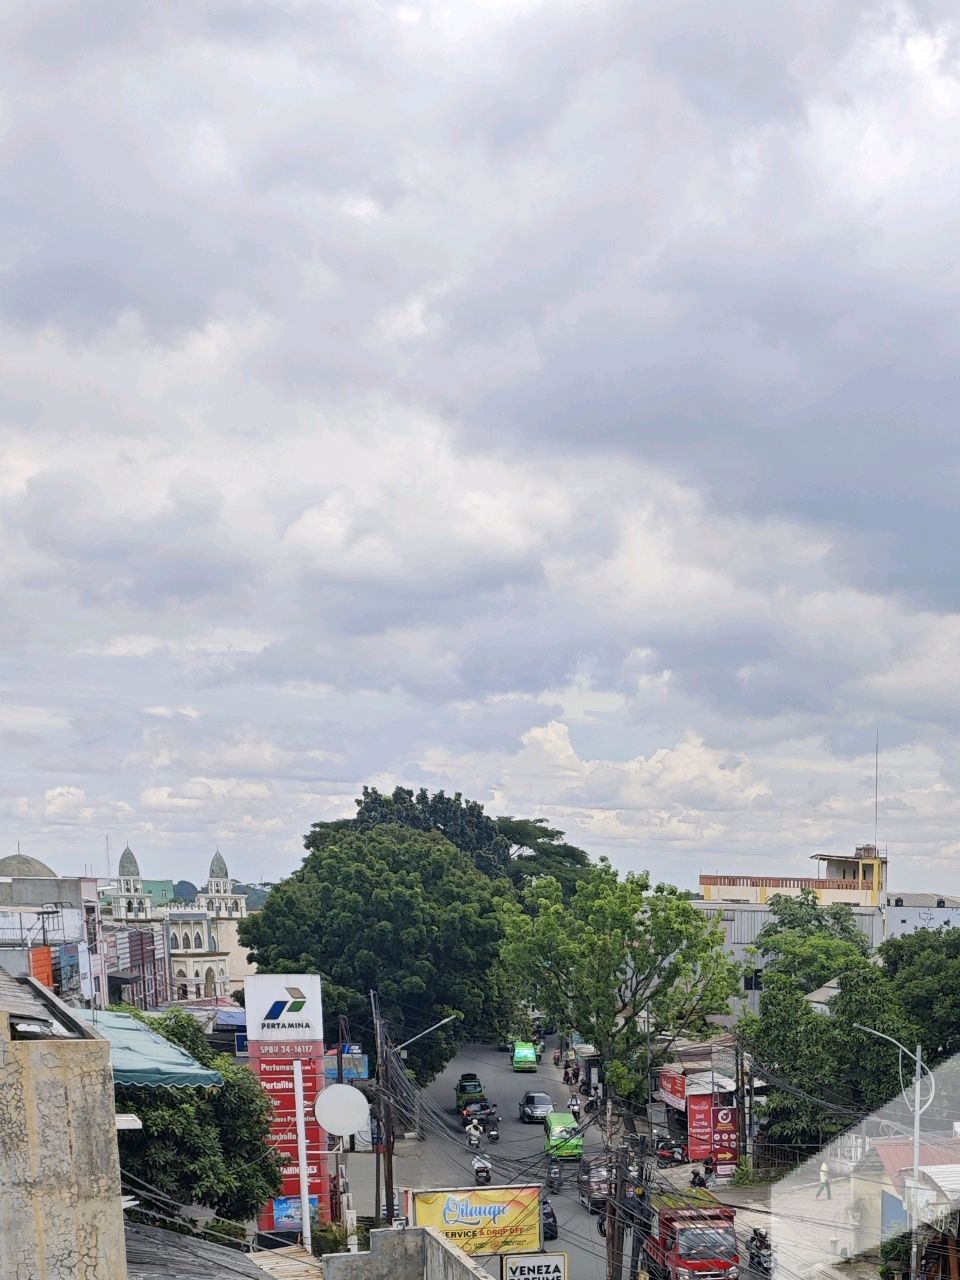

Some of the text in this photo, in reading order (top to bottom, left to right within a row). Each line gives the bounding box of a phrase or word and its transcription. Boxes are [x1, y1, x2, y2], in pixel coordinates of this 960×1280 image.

[261, 1022, 310, 1030] PERTAMINA
[260, 1045, 313, 1054] SPBU 34-16117
[444, 1230, 478, 1239] ERVICE
[509, 1264, 561, 1277] VENEZA
